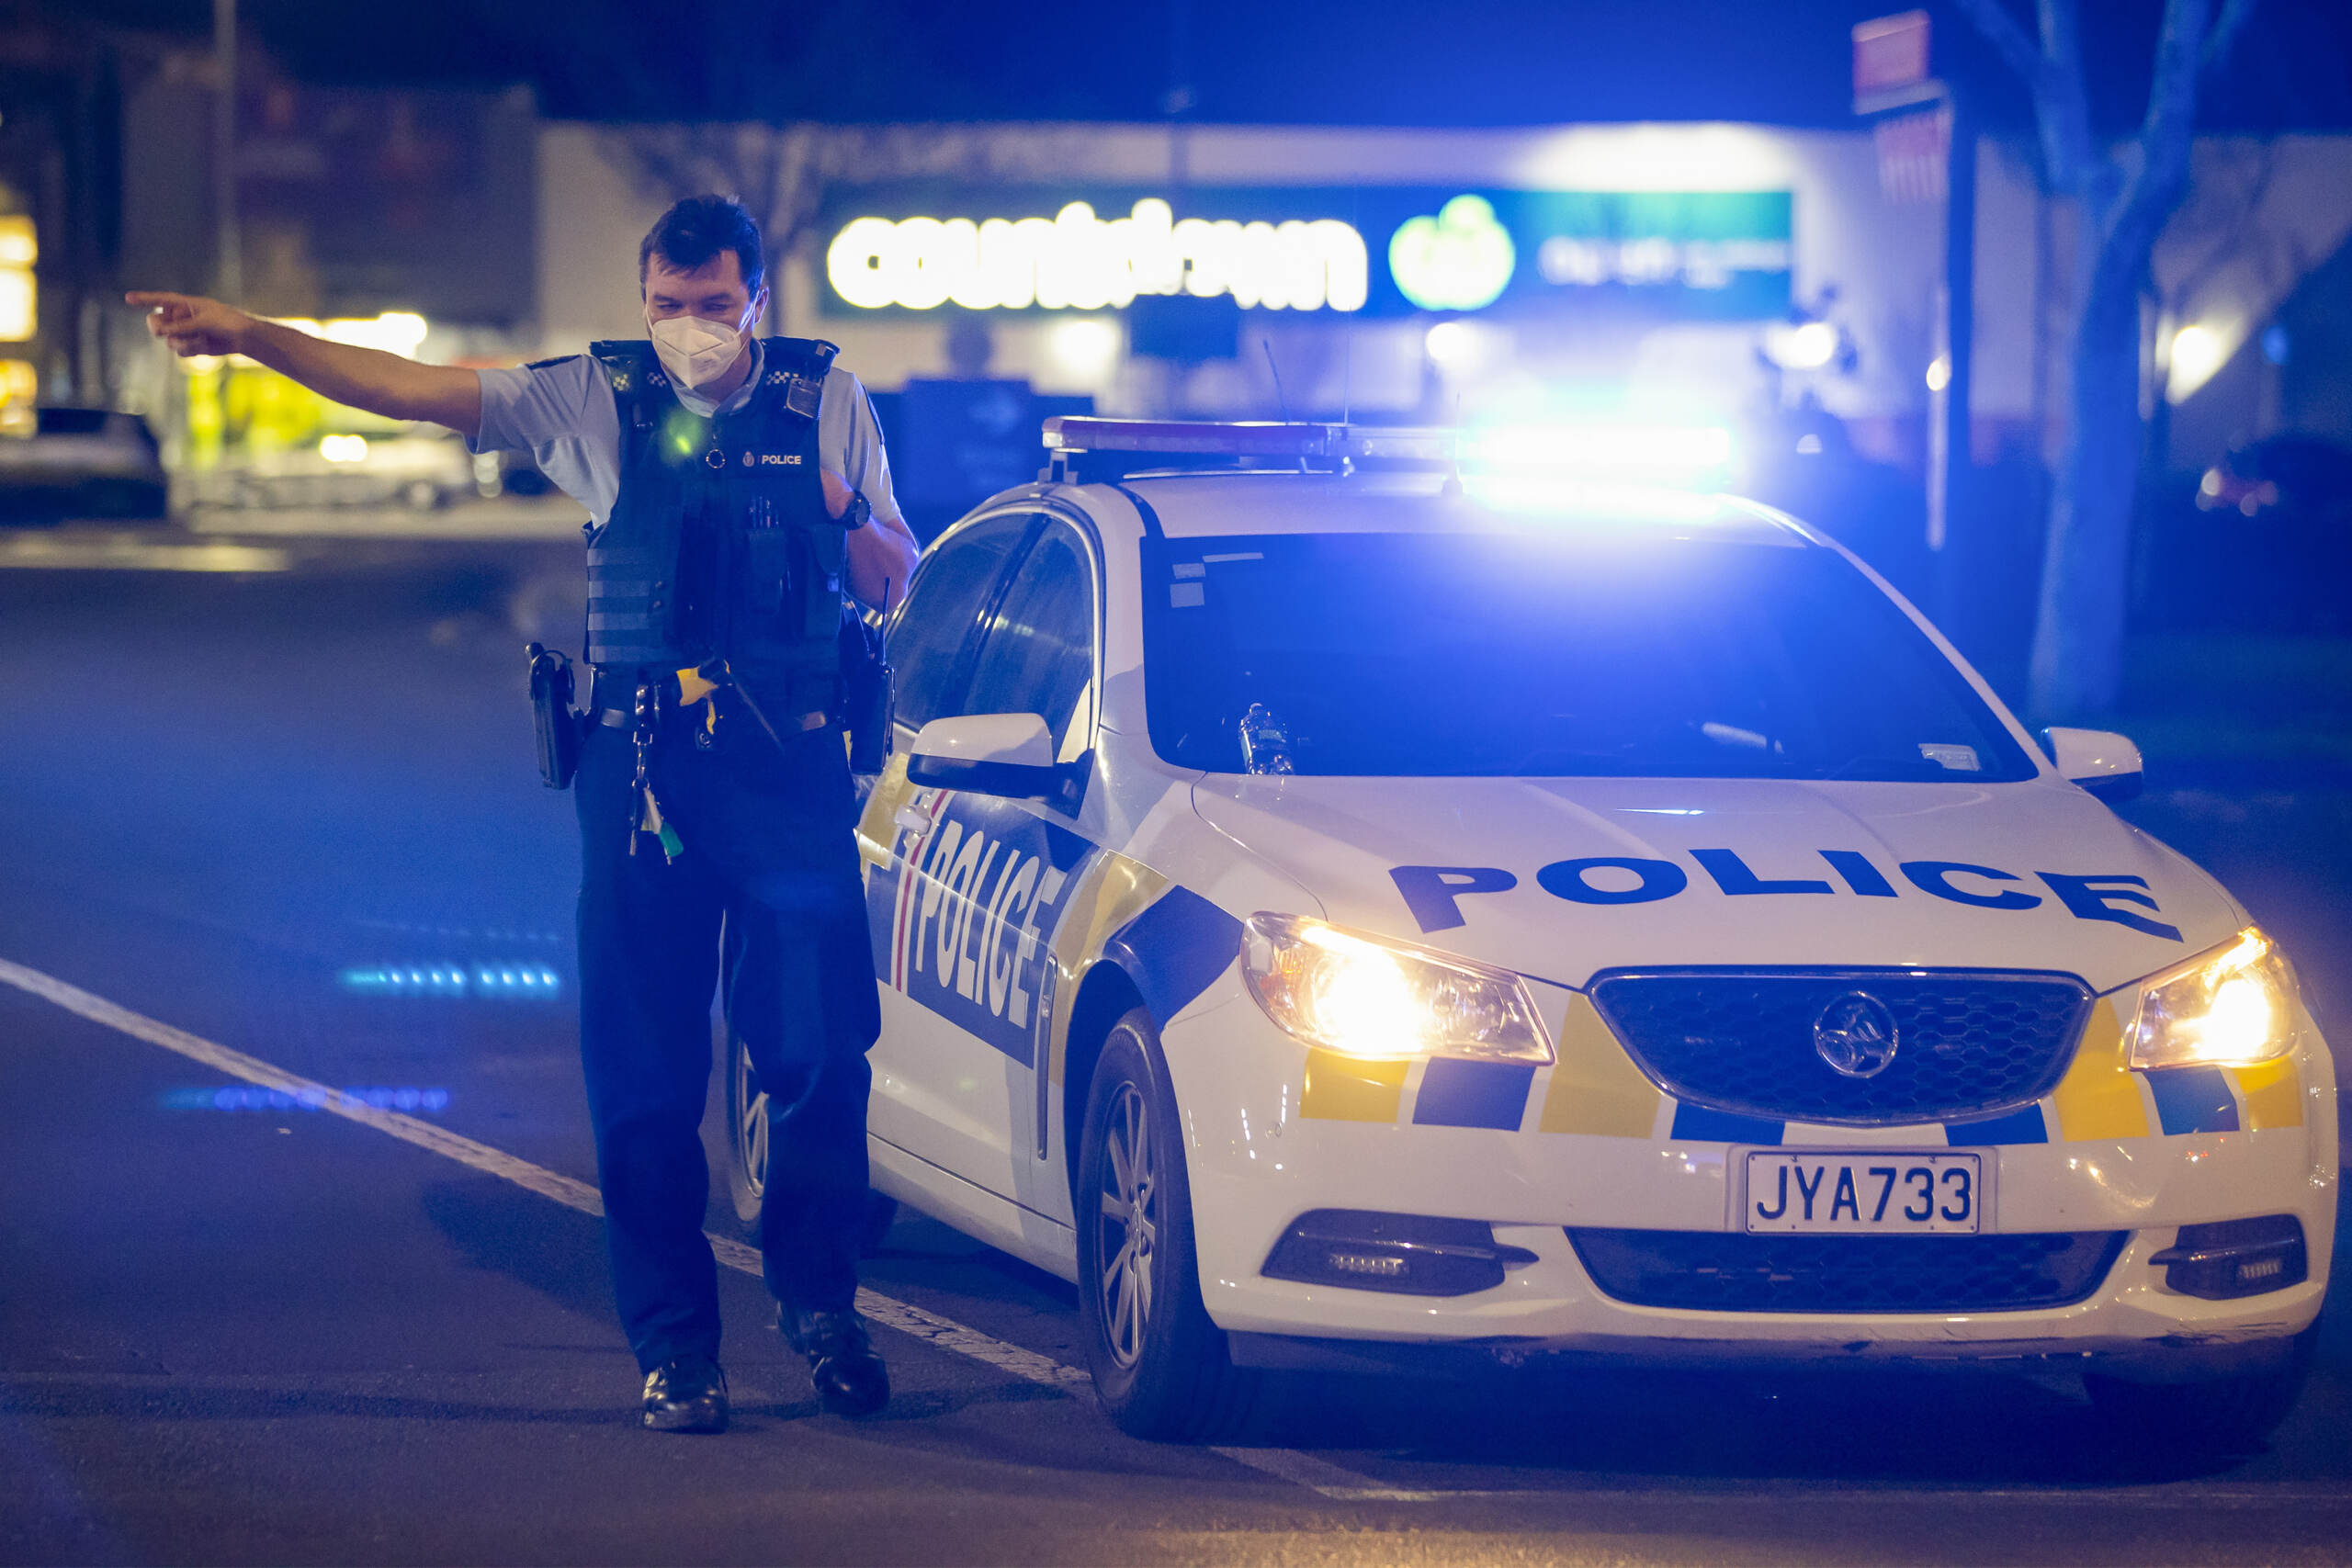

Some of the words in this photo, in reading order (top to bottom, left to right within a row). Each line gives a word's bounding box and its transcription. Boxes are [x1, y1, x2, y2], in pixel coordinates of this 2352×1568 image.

[762, 455, 801, 464] POLICE
[916, 820, 1068, 1029] POLICE
[1388, 849, 2185, 942] POLICE
[1757, 1166, 1972, 1222] JYA733
